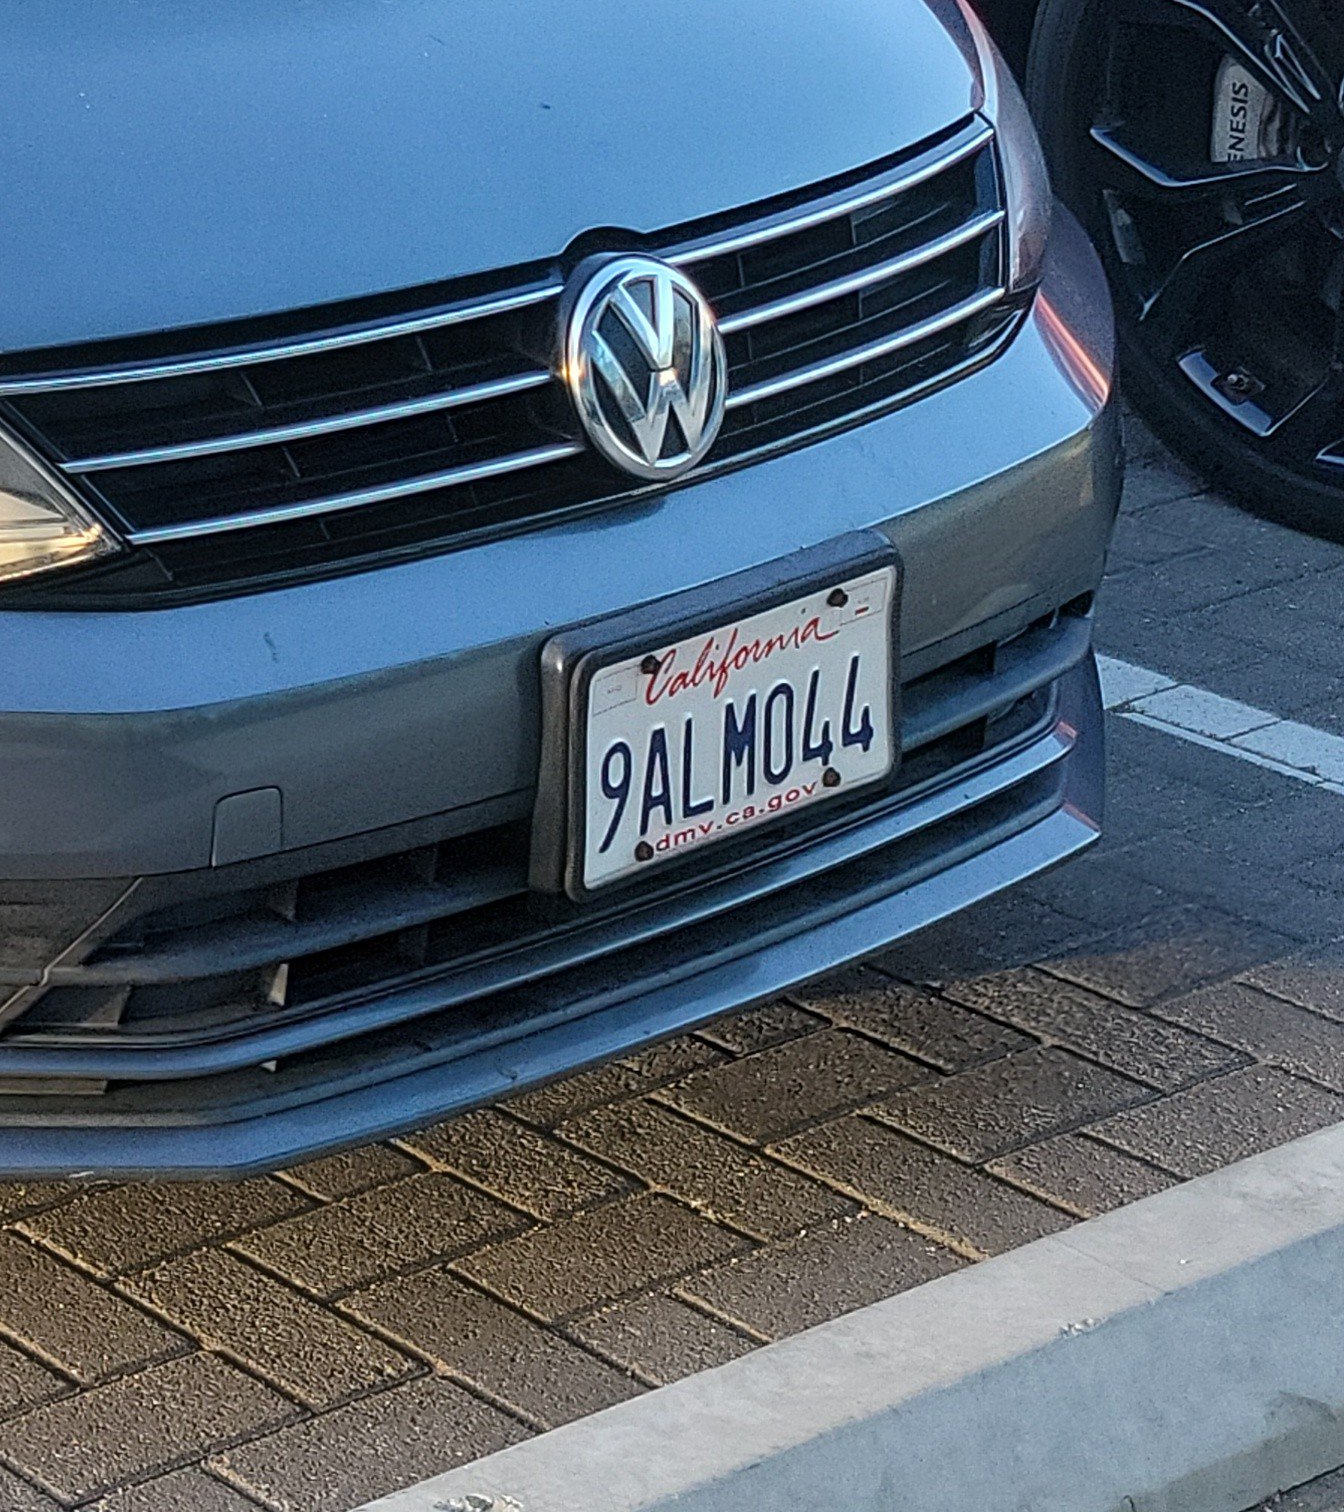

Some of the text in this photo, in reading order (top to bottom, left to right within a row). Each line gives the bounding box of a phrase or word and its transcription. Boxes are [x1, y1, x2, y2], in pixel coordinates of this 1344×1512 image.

[1227, 81, 1249, 163] ENESIS
[644, 608, 839, 705] California
[598, 655, 874, 854] 9ALM044
[655, 780, 818, 852] dmv.ca.gov
